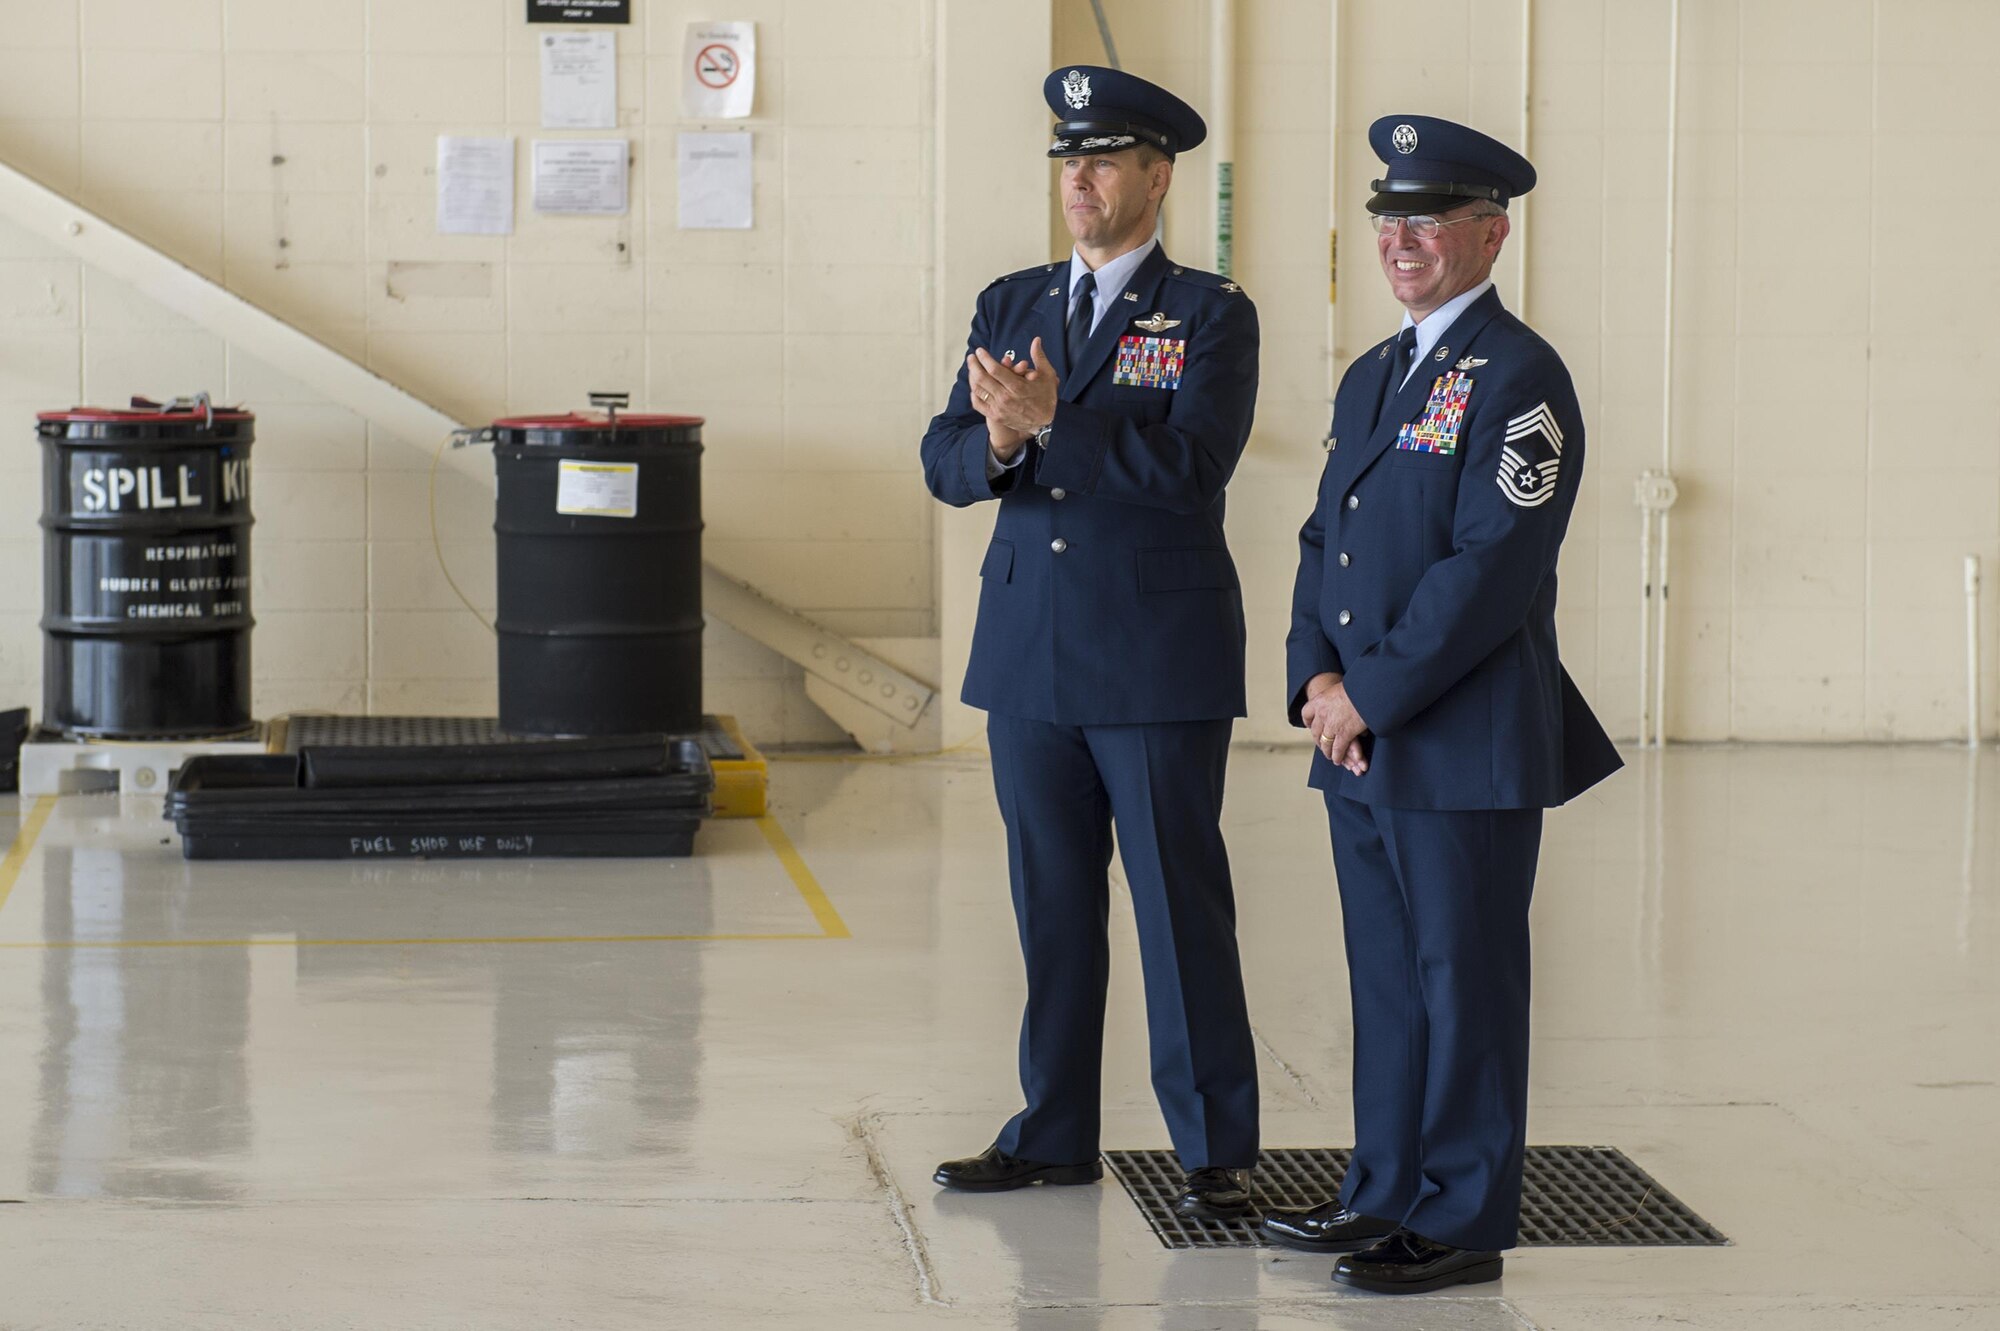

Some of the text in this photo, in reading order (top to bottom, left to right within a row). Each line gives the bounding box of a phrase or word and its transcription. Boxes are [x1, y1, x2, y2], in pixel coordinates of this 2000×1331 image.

[82, 464, 202, 510] SPILL
[127, 602, 203, 618] CHEMICAL
[350, 835, 534, 854] FUEL SHOP USE ONLY
